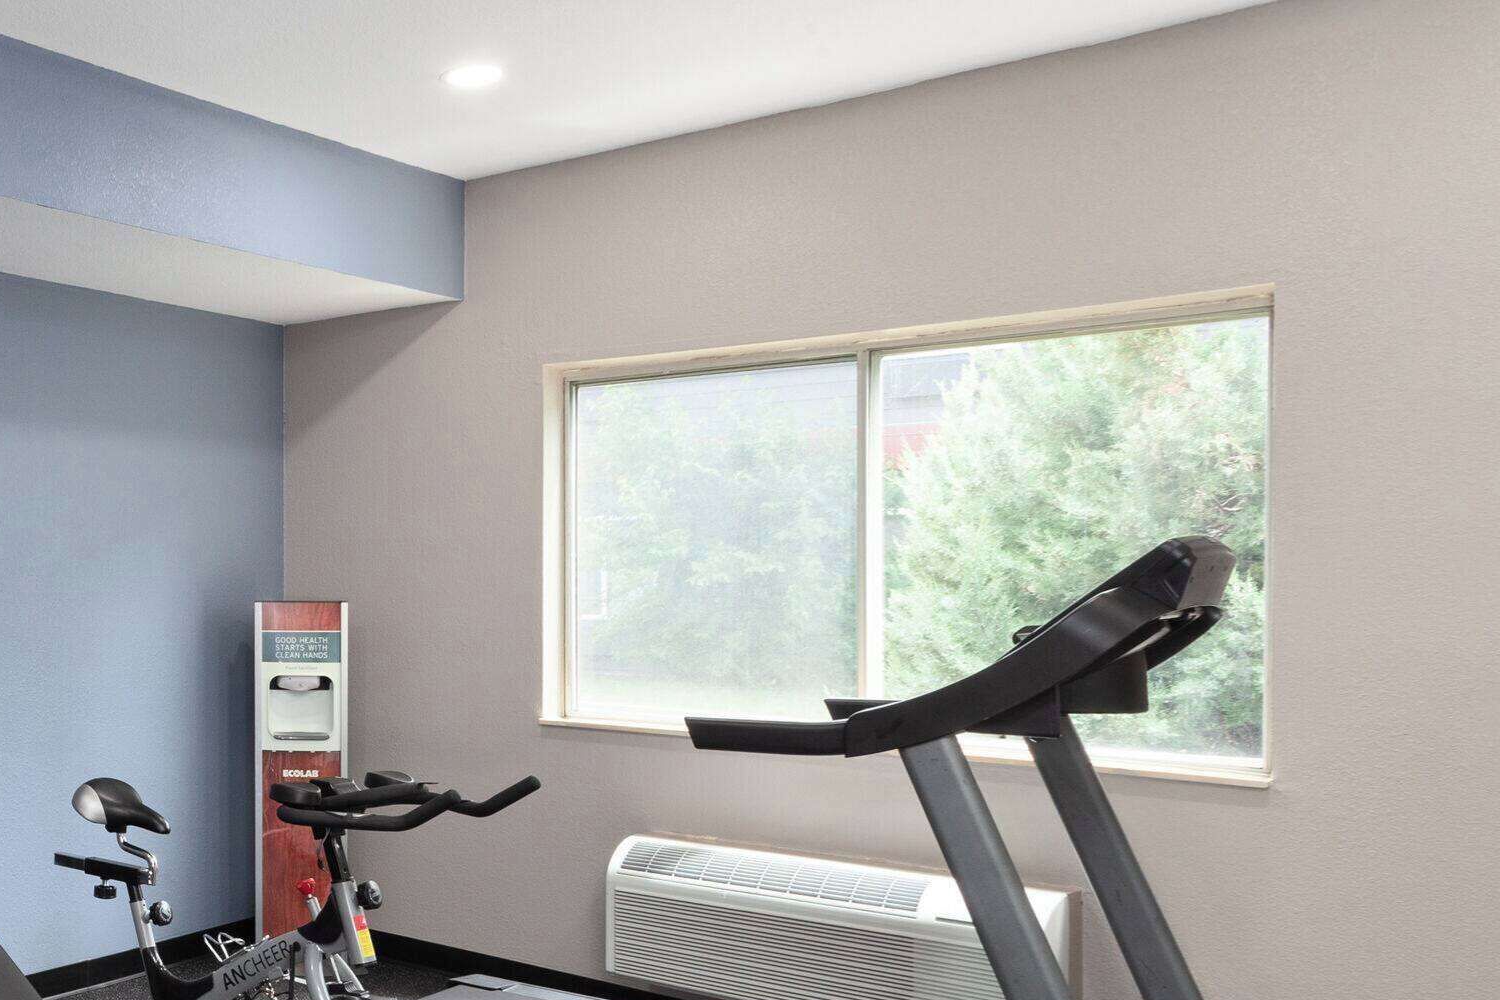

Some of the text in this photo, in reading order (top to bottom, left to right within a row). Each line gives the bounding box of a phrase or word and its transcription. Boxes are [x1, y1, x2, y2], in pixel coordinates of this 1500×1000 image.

[274, 636, 328, 644] GOOD HEALTH
[274, 651, 328, 659] CLEAN HANDS
[282, 769, 319, 778] ECOLAB
[222, 940, 291, 991] ANCHEER
